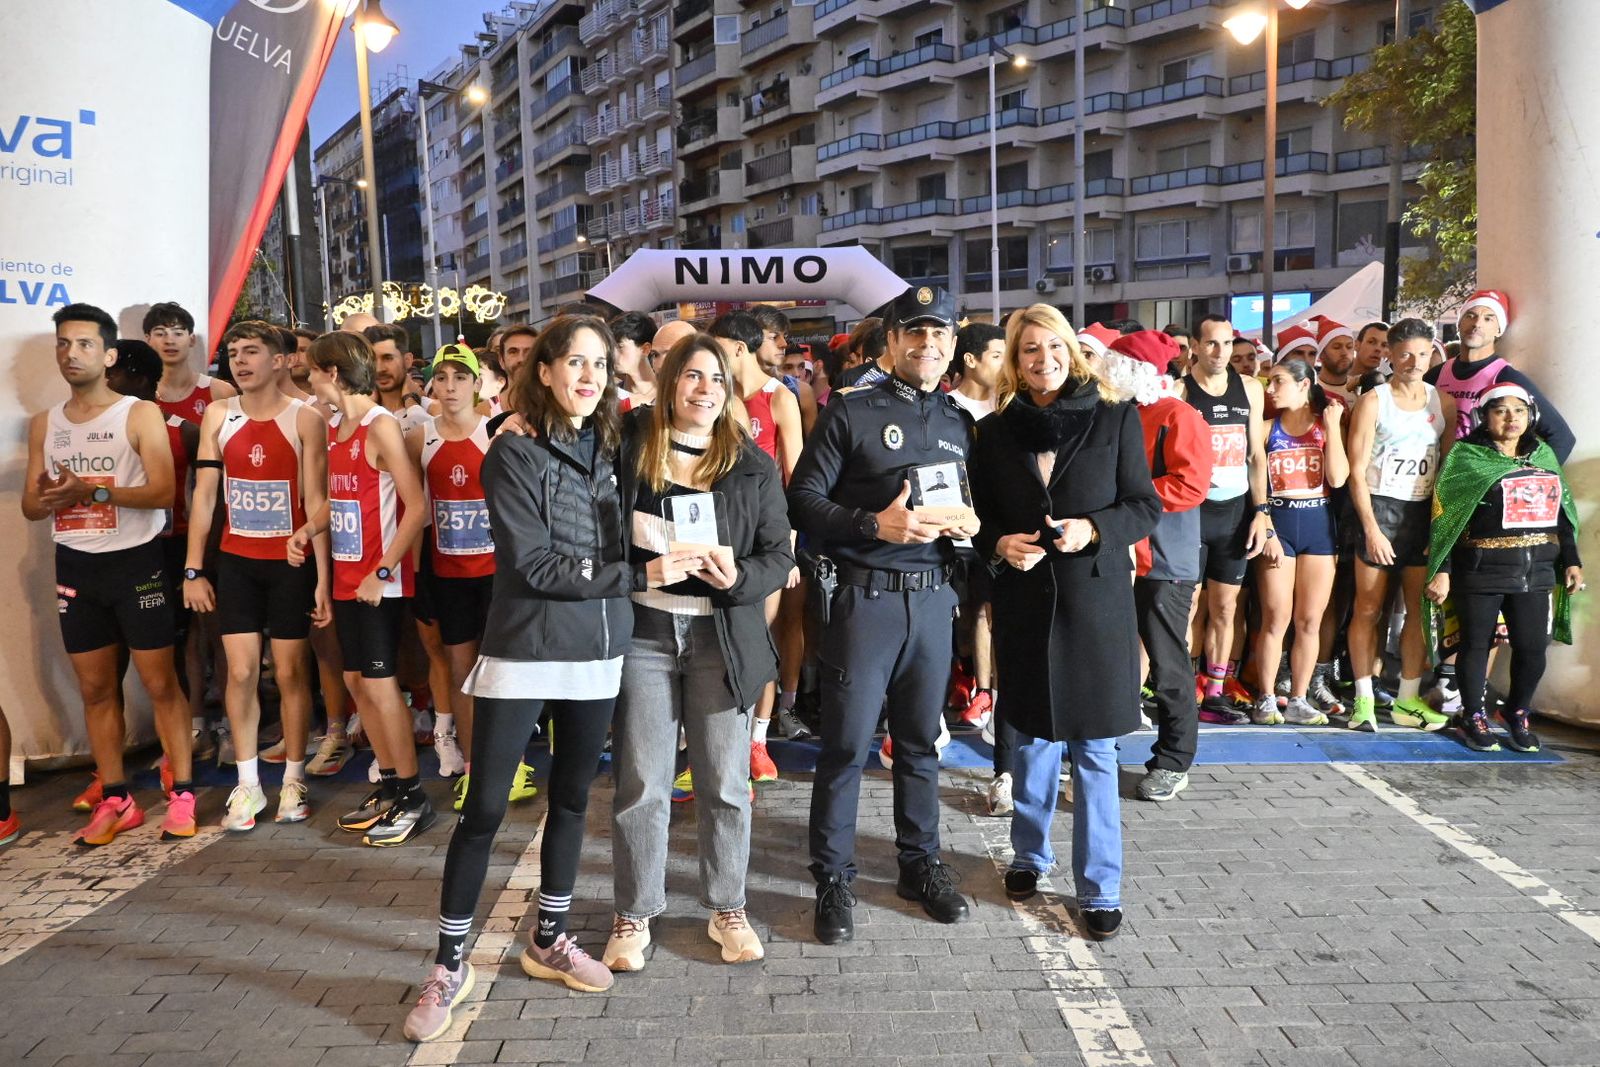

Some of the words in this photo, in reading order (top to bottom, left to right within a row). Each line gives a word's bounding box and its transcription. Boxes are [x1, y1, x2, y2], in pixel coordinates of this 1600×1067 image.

[51, 262, 73, 277] de
[674, 255, 828, 285] NIMO
[893, 378, 918, 396] POLICIA
[895, 388, 915, 402] LOCAL
[938, 439, 964, 457] POLICIA
[50, 451, 115, 475] bathco
[1271, 455, 1321, 475] 1945
[1393, 458, 1428, 476] 720
[231, 489, 287, 512] 2652
[1288, 499, 1319, 509] NIKE
[437, 508, 491, 530] 2573
[138, 597, 166, 610] TEAM
